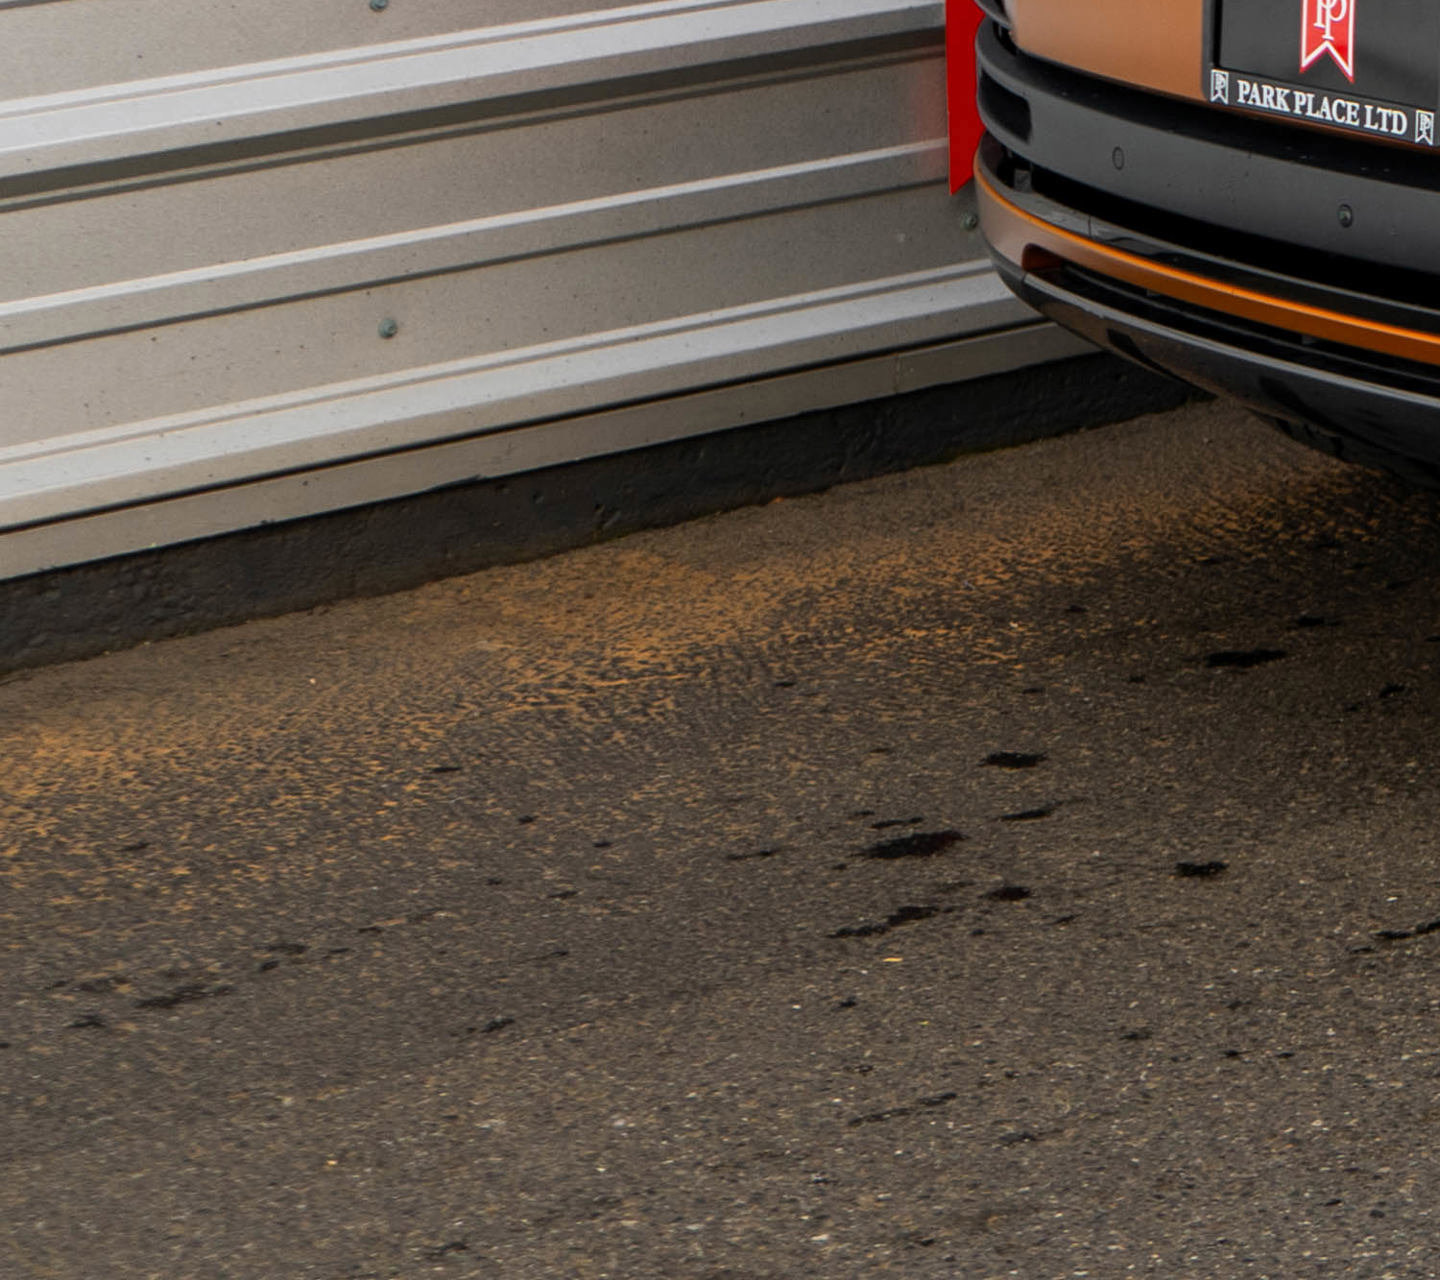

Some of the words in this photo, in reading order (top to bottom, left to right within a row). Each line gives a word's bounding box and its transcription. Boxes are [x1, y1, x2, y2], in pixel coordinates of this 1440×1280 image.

[1237, 79, 1291, 112] PARK
[1293, 91, 1361, 127] PLACE
[1363, 104, 1408, 135] LTD
